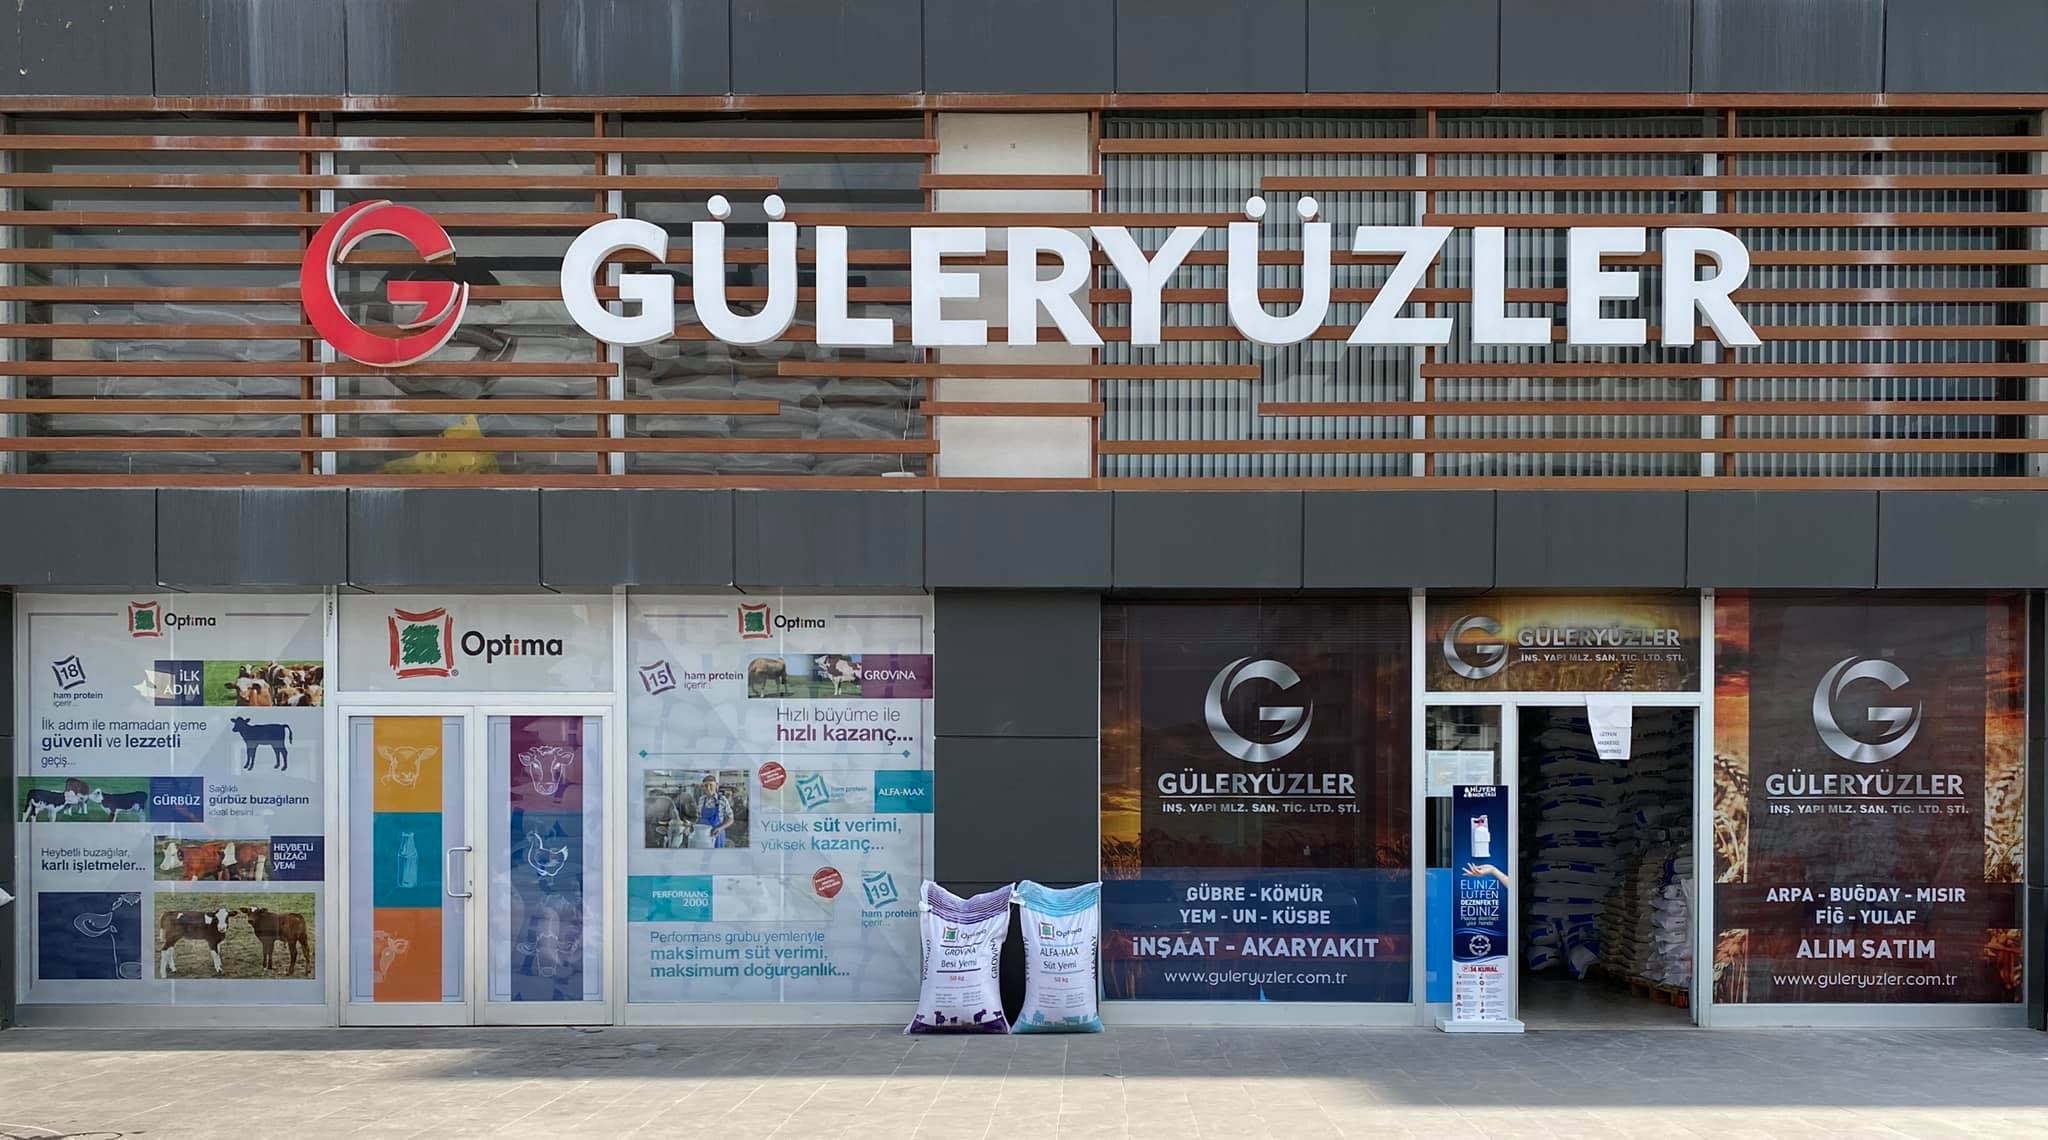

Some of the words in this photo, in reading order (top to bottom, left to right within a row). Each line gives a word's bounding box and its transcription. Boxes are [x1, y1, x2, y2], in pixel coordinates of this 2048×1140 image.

[560, 195, 1762, 347] GÜLERYÜZLER
[164, 612, 216, 630] Optima
[774, 615, 825, 632] Optima
[1518, 622, 1681, 646] GÜLERYÜZLER
[460, 630, 563, 664] Optima
[1544, 654, 1567, 662] YAPI
[1570, 654, 1593, 662] MLZ.
[1595, 654, 1619, 662] SAN.
[1643, 654, 1664, 662] LTD.
[60, 663, 79, 679] 18
[179, 668, 200, 682] İLK
[649, 669, 668, 687] 15
[684, 672, 707, 681] ham
[708, 672, 744, 683] protein
[53, 691, 72, 700] ham
[73, 691, 103, 702] protein
[163, 684, 200, 695] ADIM
[776, 707, 809, 722] Hızlı
[815, 707, 879, 725] büyüme
[884, 707, 901, 721] ile
[42, 718, 55, 731] İlk
[58, 718, 89, 731] adım
[92, 718, 106, 731] ile
[109, 718, 170, 731] mamadan
[173, 722, 207, 734] yeme
[42, 734, 102, 751] güvenli
[106, 737, 122, 748] ve
[125, 734, 181, 749] lezzetli
[776, 724, 817, 742] hızlı
[824, 724, 914, 746] kazanç...
[1158, 768, 1356, 795] GÜLERYÜZLER
[1765, 768, 1965, 796] GÜLERYÜZLER
[153, 792, 200, 806] GÜRBÜZ
[804, 783, 822, 801] 21
[878, 787, 925, 798] ALFA-MAX
[208, 794, 248, 808] gürbüz
[1162, 802, 1186, 815] İNŞ.
[1189, 803, 1217, 813] YAPI
[1220, 803, 1249, 813] MLZ.
[1252, 803, 1280, 813] SAN.
[1282, 801, 1306, 813] TİC.
[1310, 803, 1335, 813] LTD.
[1770, 802, 1794, 816] İNŞ.
[1797, 804, 1825, 814] YAPI
[1828, 804, 1857, 814] MLZ.
[1860, 804, 1888, 814] SAN.
[1918, 804, 1943, 814] LTD.
[760, 820, 809, 833] Yüksek
[813, 818, 841, 833] süt
[845, 818, 903, 835] verimi,
[42, 848, 82, 860] Heybetli
[760, 838, 806, 853] yüksek
[811, 836, 885, 855] kazanç...
[273, 851, 308, 861] BUZAĞI
[42, 859, 70, 872] karlı
[73, 859, 146, 873] işletmeler...
[652, 890, 710, 899] PERFORMANS
[871, 882, 890, 899] 19
[1187, 884, 1246, 902] GÜBRE
[1261, 884, 1324, 902] KÖMÜR
[1766, 888, 1814, 902] ARPA
[1830, 884, 1901, 902] BUĞDAY
[1917, 888, 1966, 903] MISIR
[682, 898, 710, 908] 2000
[862, 910, 882, 918] ham
[884, 910, 919, 920] protein
[1180, 909, 1216, 924] YEM
[1232, 909, 1257, 925] UN
[1272, 907, 1331, 925] KÜSBE
[1816, 906, 1844, 924] FİĞ
[1860, 910, 1917, 925] YULAF
[650, 930, 722, 943] Performans
[724, 930, 762, 947] grubu
[764, 930, 825, 946] yemleriyle
[650, 946, 740, 960] maksimum
[744, 946, 771, 960] süt
[774, 946, 829, 962] verimi,
[1040, 947, 1080, 958] ALFA-MAX
[1241, 938, 1379, 958] AKARYAKIT
[1796, 940, 1855, 959] ALIM
[1862, 940, 1936, 959] SATIM
[650, 963, 740, 977] maksimum
[744, 962, 850, 980] doğurganlık...
[1164, 971, 1348, 986] www.guleryuzler.com.tr
[1773, 973, 1958, 989] www.guleryuzler.com.tr
